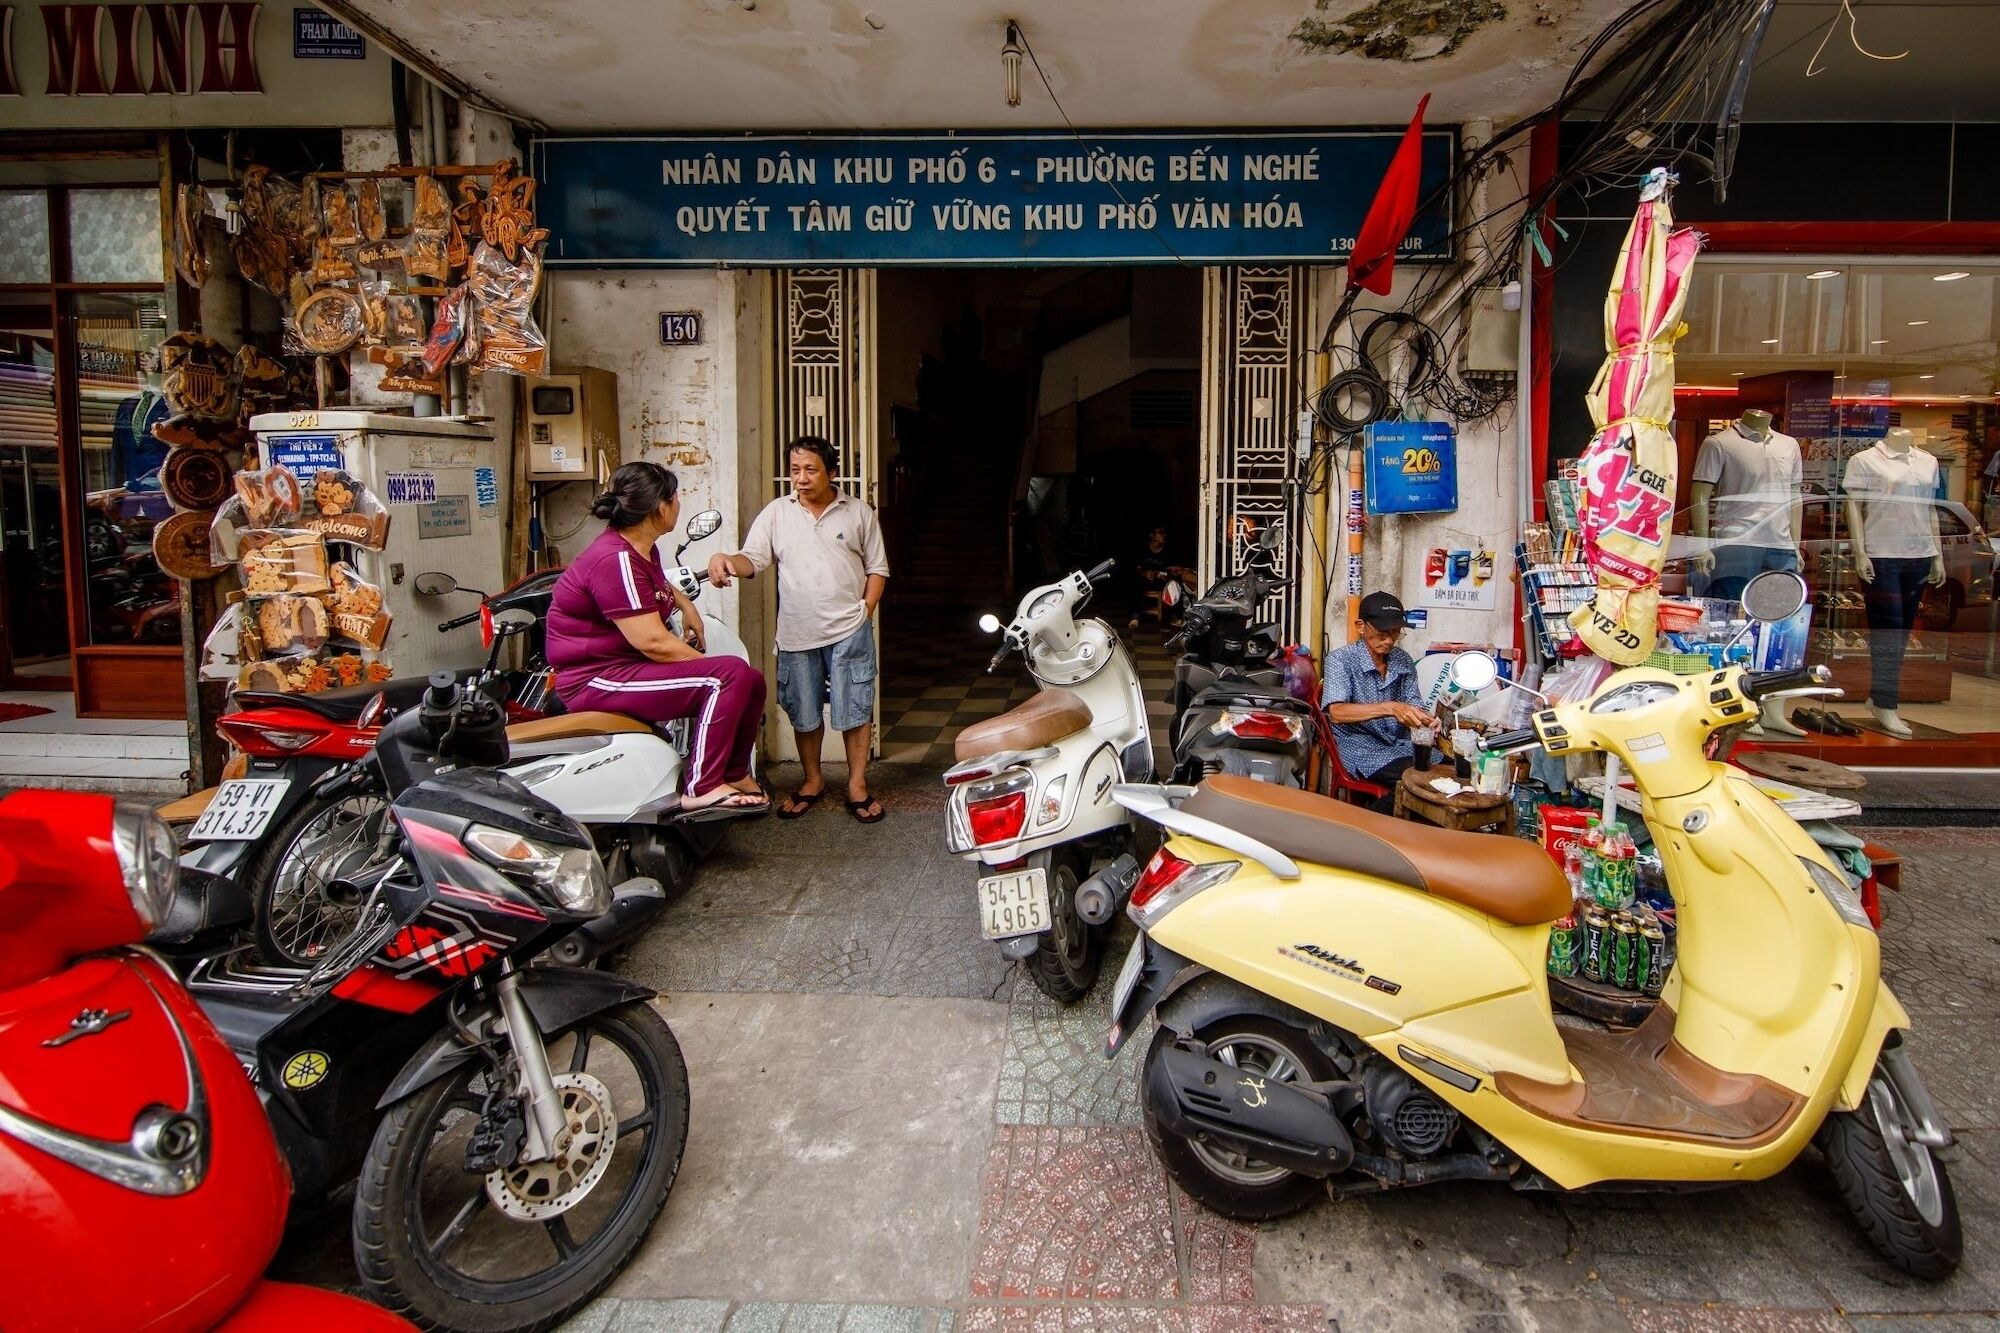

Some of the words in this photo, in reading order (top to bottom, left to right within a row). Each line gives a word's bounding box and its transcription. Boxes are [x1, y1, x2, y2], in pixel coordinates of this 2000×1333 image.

[39, 3, 264, 96] MINH
[662, 152, 741, 184] NHÂN
[756, 151, 816, 184] DÂN
[834, 158, 893, 184] KHU
[908, 147, 969, 184] PHỐ
[978, 157, 996, 183] 6
[1036, 146, 1155, 183] PHƯỜNG
[1168, 145, 1229, 181] BẾN
[1243, 147, 1320, 181] NGHÉ
[676, 197, 770, 237] QUYẾT
[788, 200, 851, 231] TÂM
[865, 198, 916, 231] GIỮ
[932, 198, 1011, 231] VỮNG
[1024, 203, 1083, 231] KHU
[1098, 194, 1161, 230] PHỐ
[1171, 197, 1230, 229] VĂN
[1243, 194, 1304, 229] HÓA
[1330, 237, 1356, 251] 130
[666, 316, 697, 340] 130
[388, 378, 405, 390] My
[407, 380, 435, 392] Room
[1402, 447, 1441, 474] 20%
[305, 518, 368, 539] Welcome
[1614, 629, 1641, 650] 2D
[198, 811, 269, 835] 314.37
[988, 875, 1034, 906] 54-L1
[992, 902, 1040, 933] 4965
